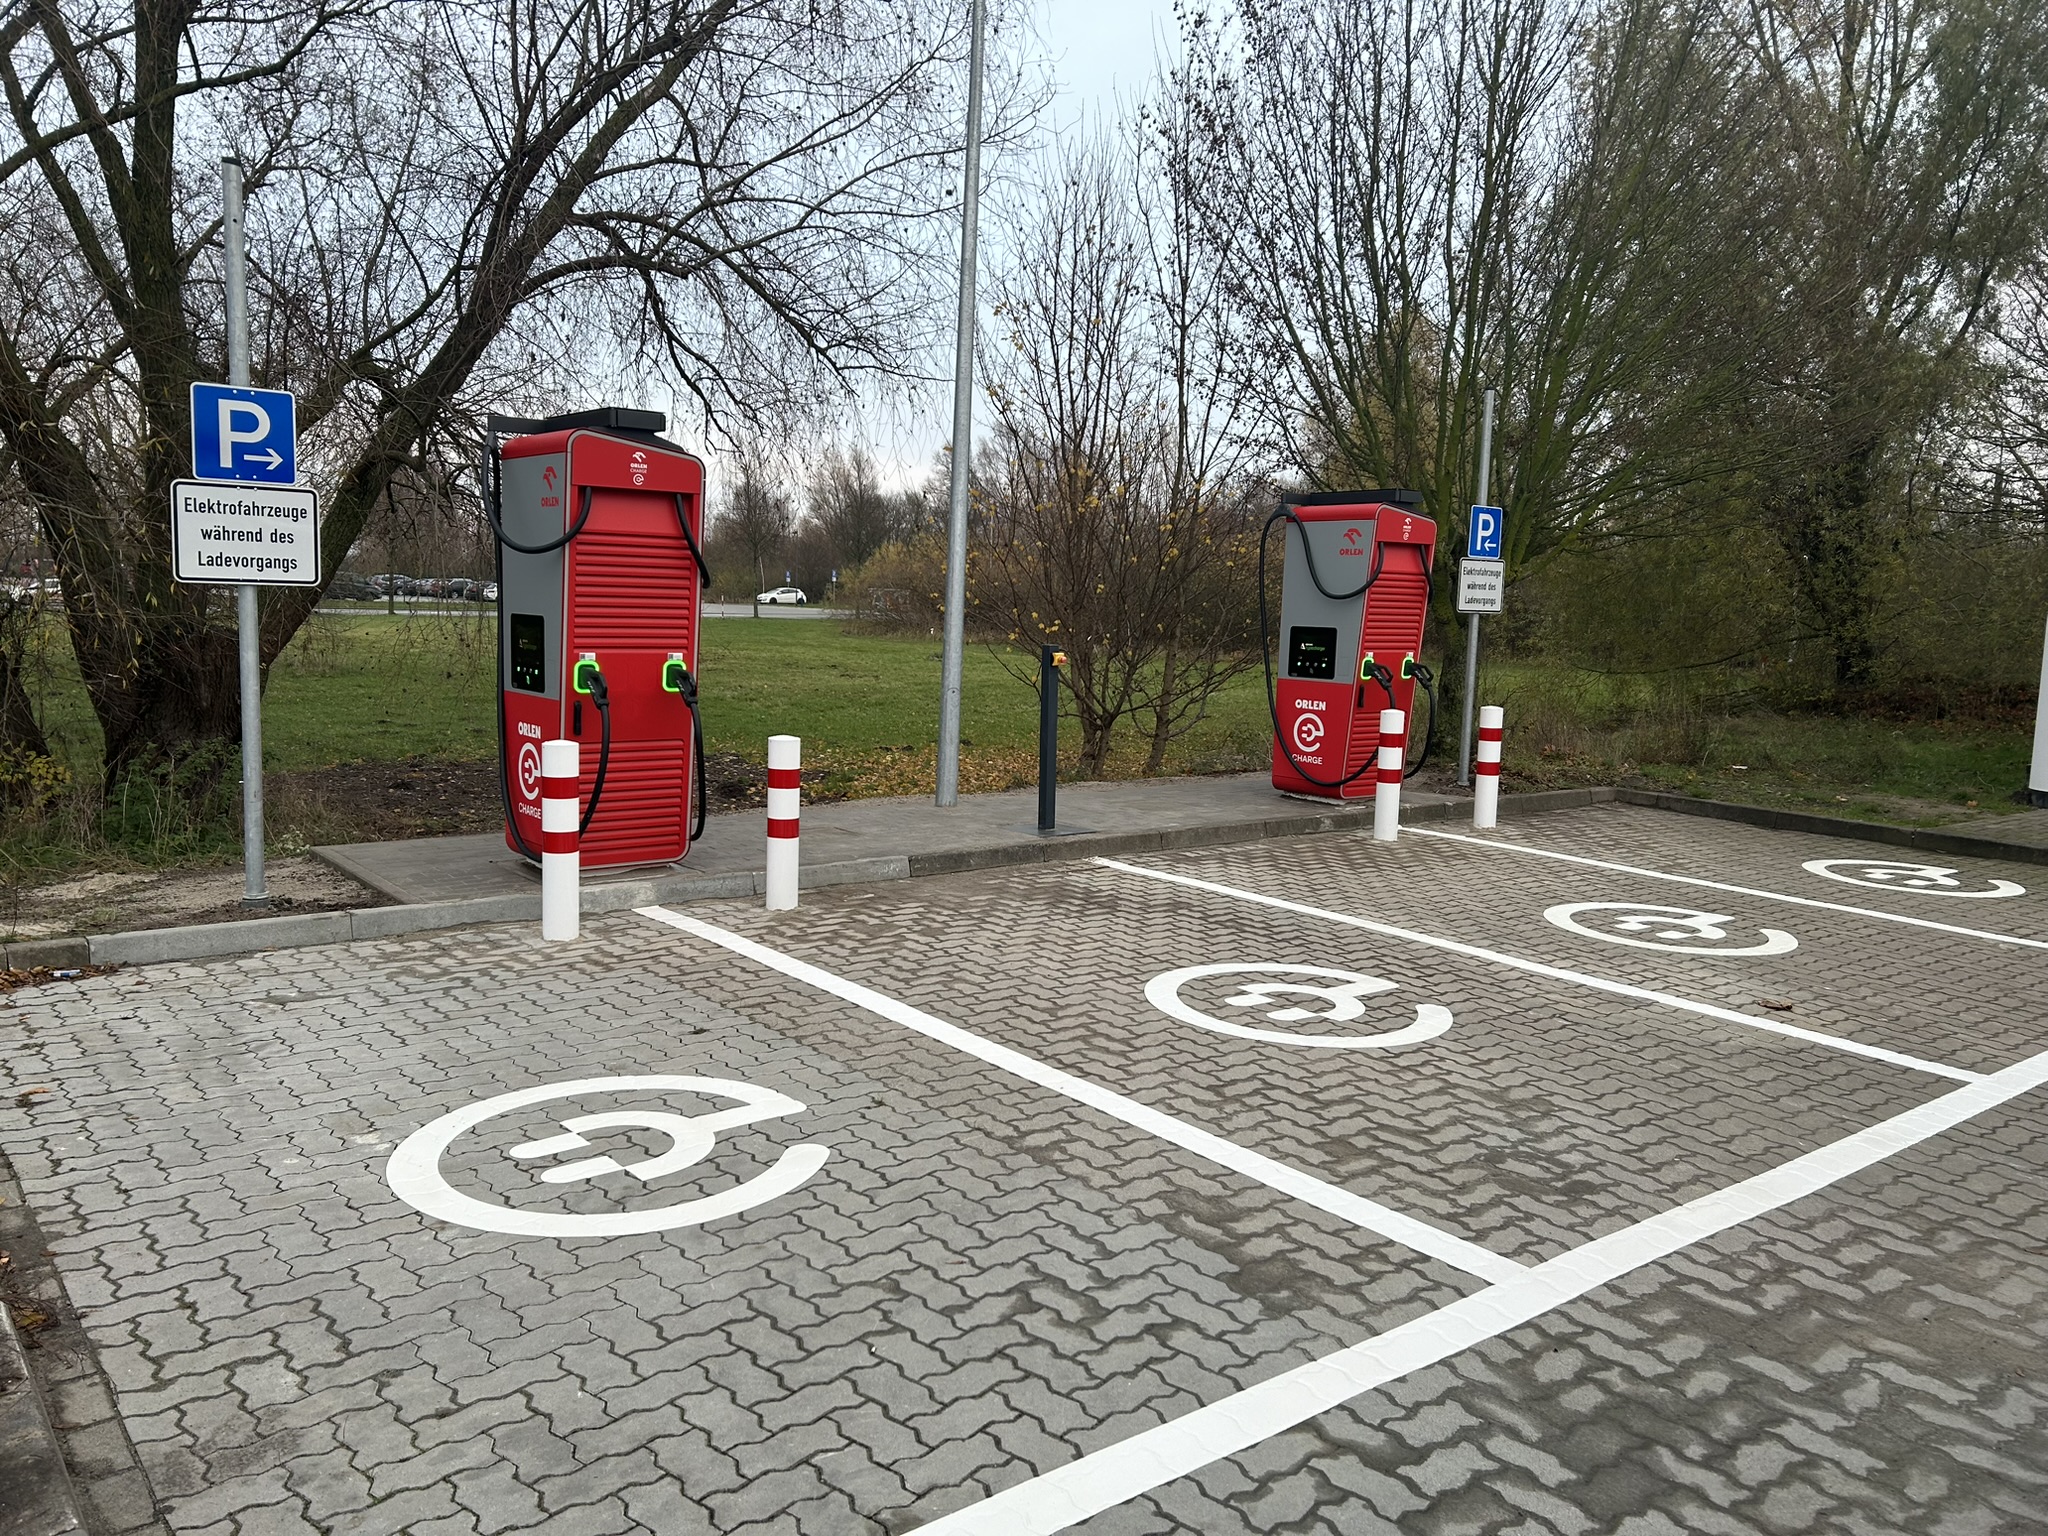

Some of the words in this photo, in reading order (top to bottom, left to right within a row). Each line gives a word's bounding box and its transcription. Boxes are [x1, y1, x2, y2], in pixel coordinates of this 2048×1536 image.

[218, 398, 271, 468] P
[541, 496, 560, 507] ORLEN
[184, 496, 308, 522] Elektrofahrzeuge
[201, 525, 263, 543] während
[270, 528, 295, 544] des
[1476, 513, 1495, 551] P
[1339, 547, 1364, 556] ORLEN
[197, 551, 298, 573] Ladevorgangs
[1463, 566, 1501, 579] Elektrofahrzeuge
[1467, 580, 1487, 591] während
[1488, 582, 1497, 591] des
[1464, 595, 1497, 607] Ladevorgangs
[1295, 699, 1326, 711] ORLEN
[518, 722, 541, 739] ORLEN
[1292, 754, 1323, 765] CHARGE
[518, 803, 541, 819] CHARGE
